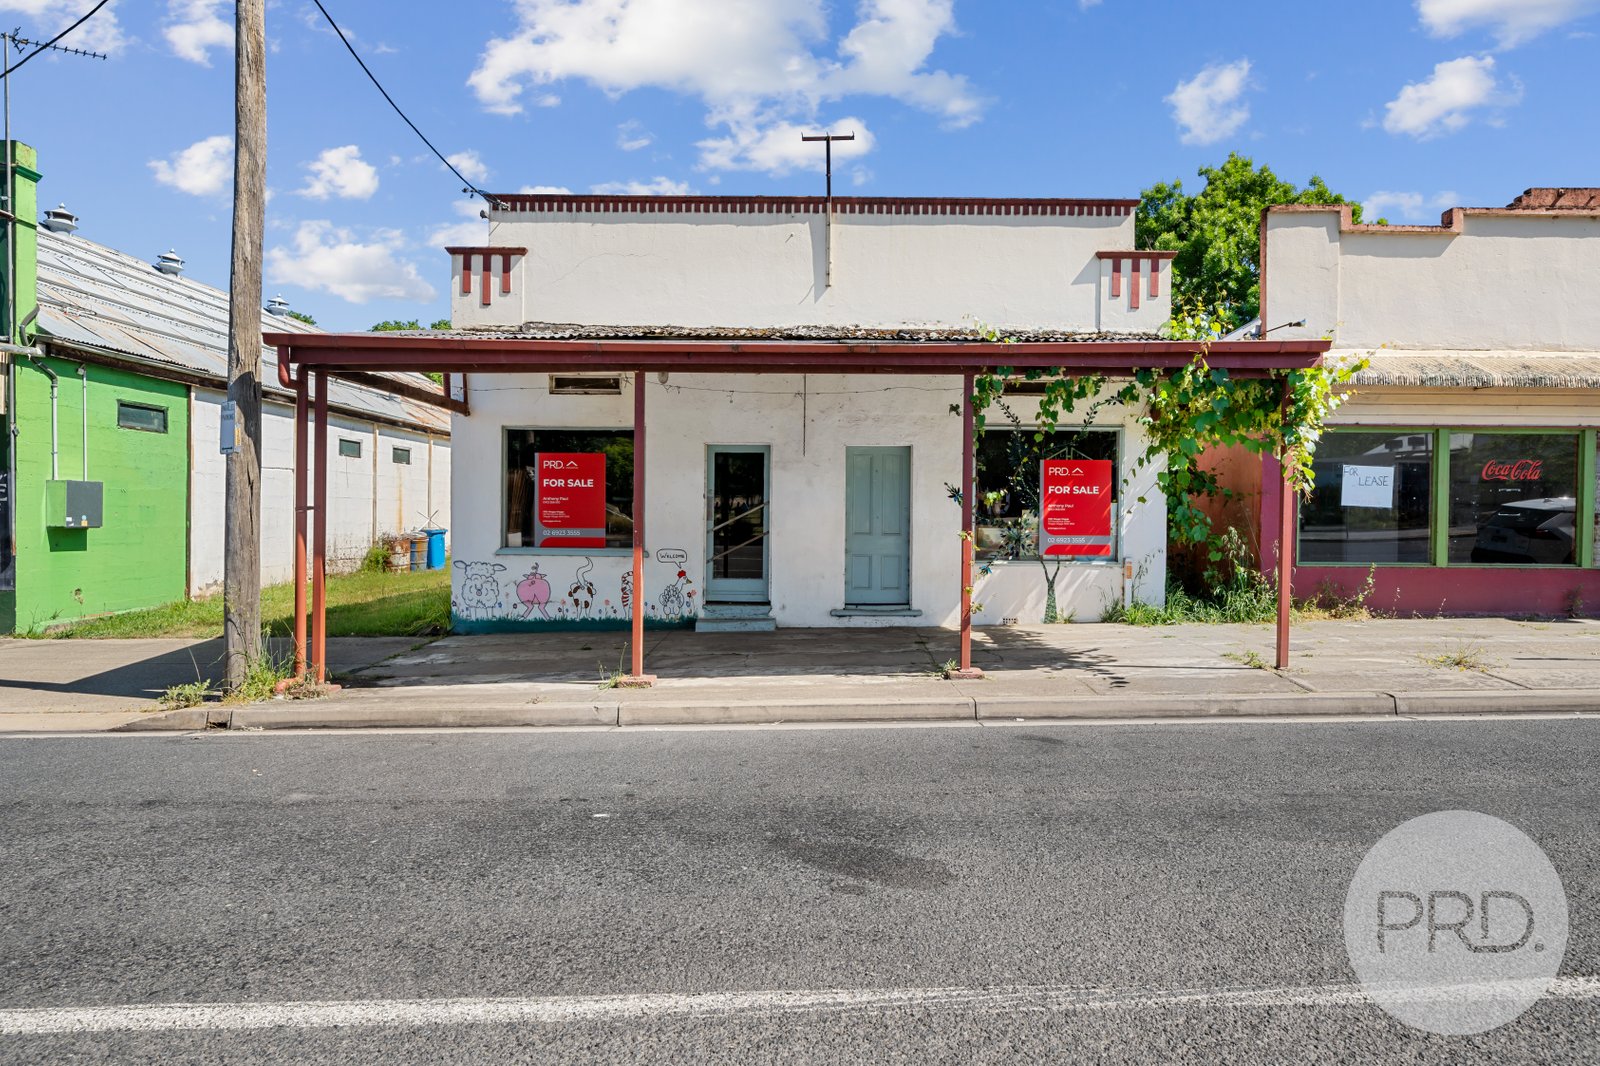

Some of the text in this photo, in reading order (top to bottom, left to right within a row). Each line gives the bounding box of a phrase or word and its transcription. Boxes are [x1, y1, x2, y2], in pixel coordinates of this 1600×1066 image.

[1344, 466, 1359, 476] FOR
[1481, 459, 1543, 481] Coca-Cola
[543, 478, 594, 488] FOR SALE
[1358, 476, 1389, 487] LEASE
[1048, 485, 1100, 495] FOR SALE
